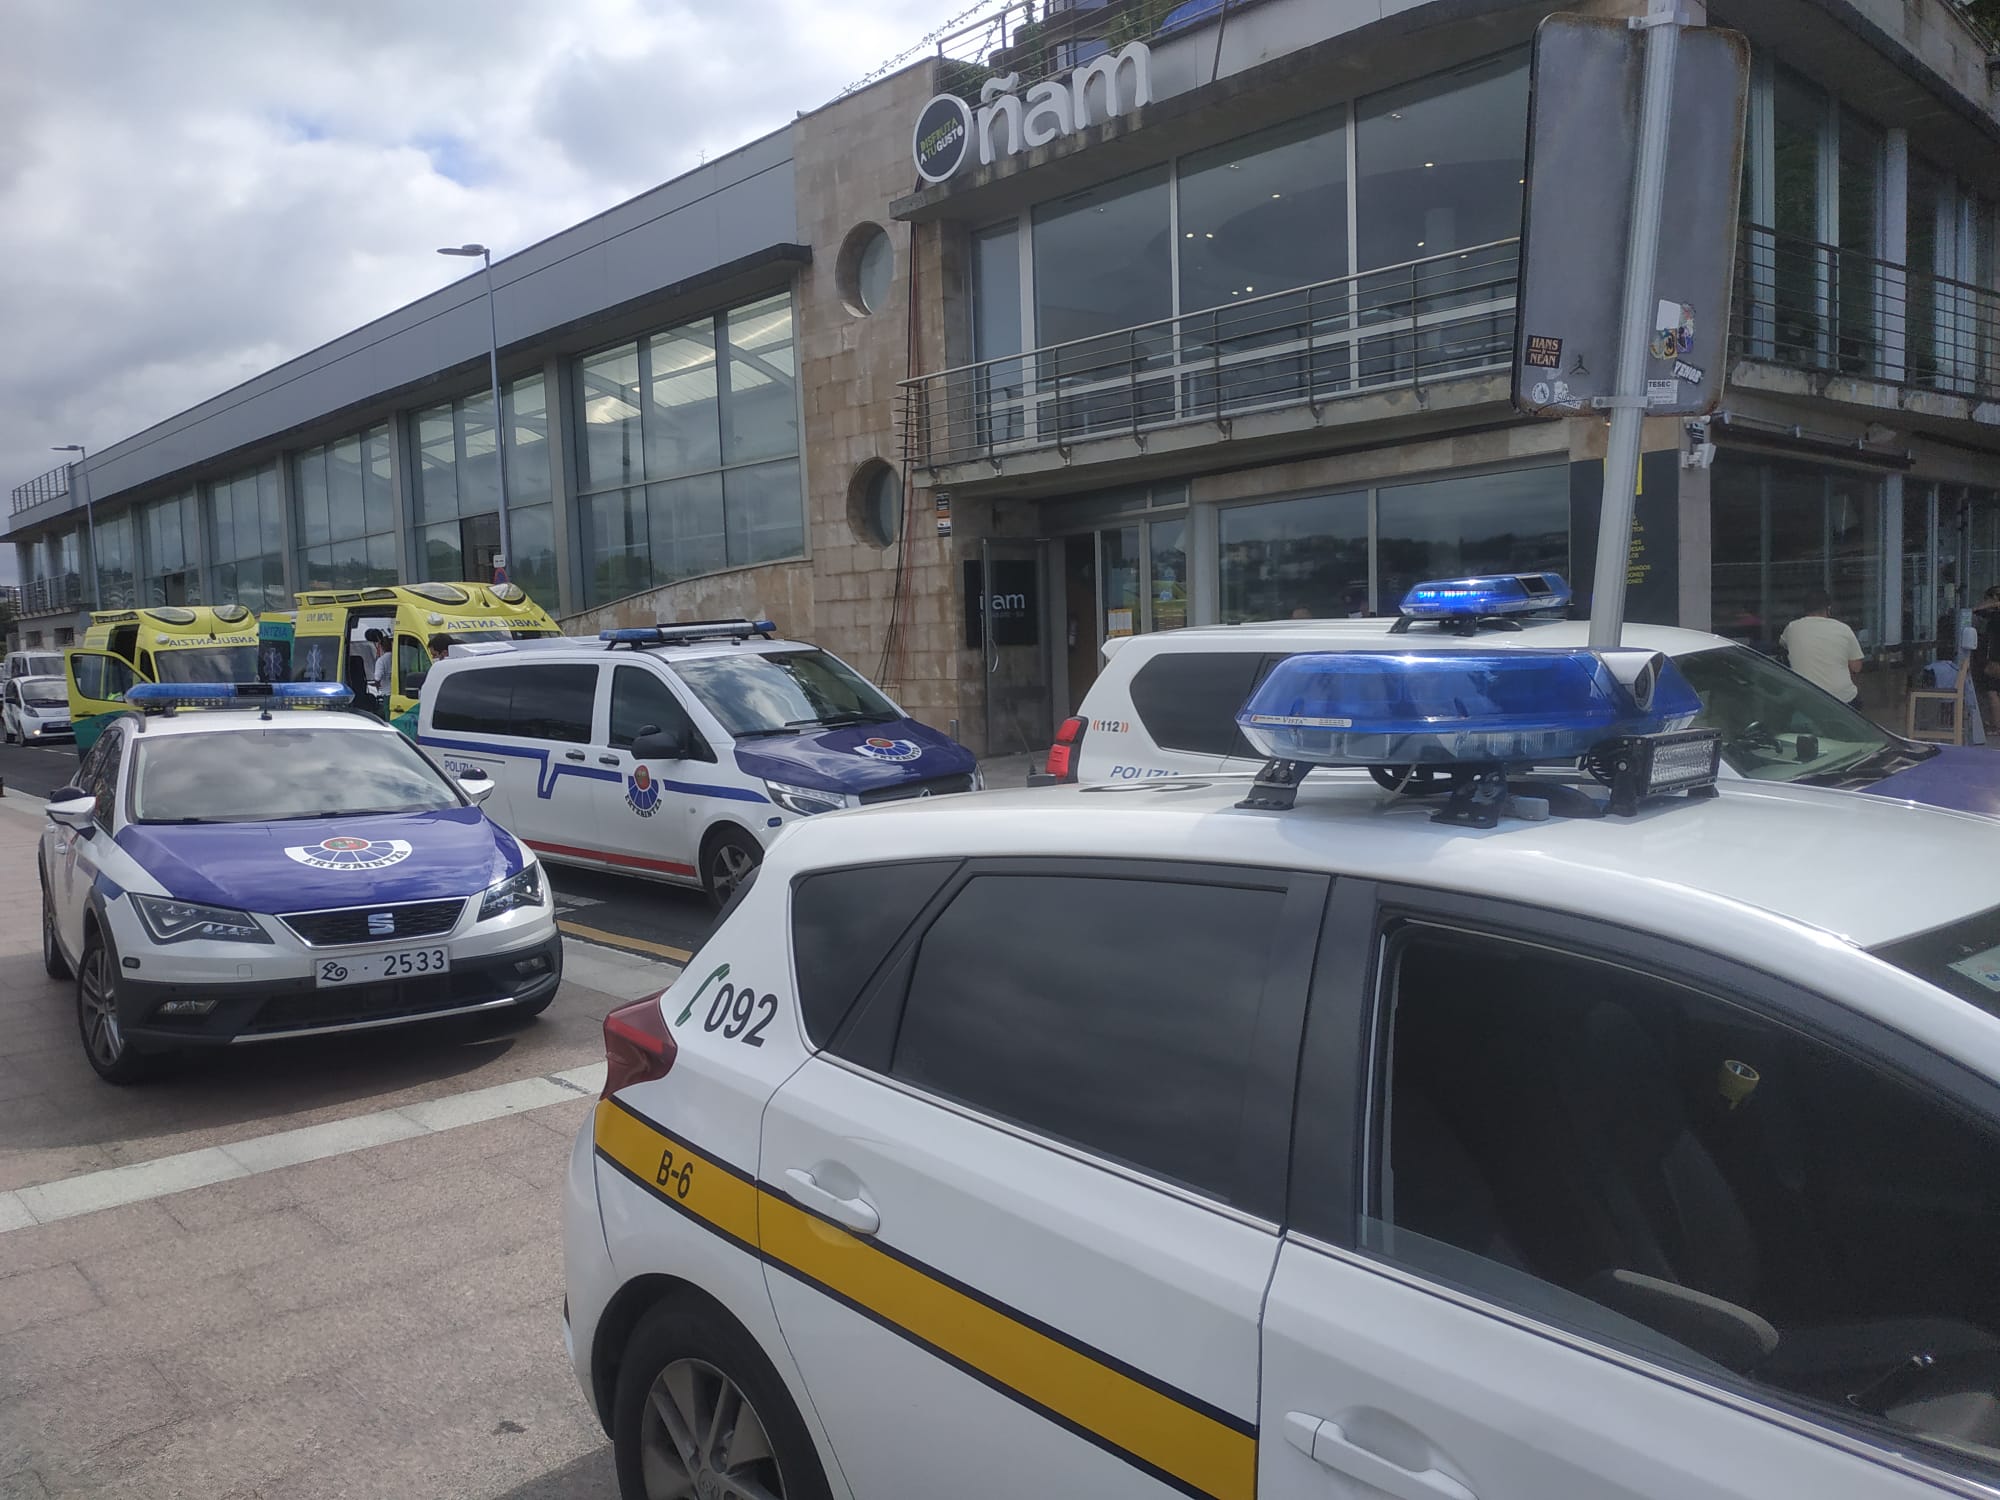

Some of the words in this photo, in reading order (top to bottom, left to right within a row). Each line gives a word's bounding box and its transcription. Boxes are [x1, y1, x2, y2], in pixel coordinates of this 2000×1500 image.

[977, 41, 1150, 165] ñam
[303, 849, 409, 870] ERTZAINTZA
[383, 949, 445, 977] 2533
[704, 983, 778, 1048] 092
[656, 1149, 693, 1199] B-6
